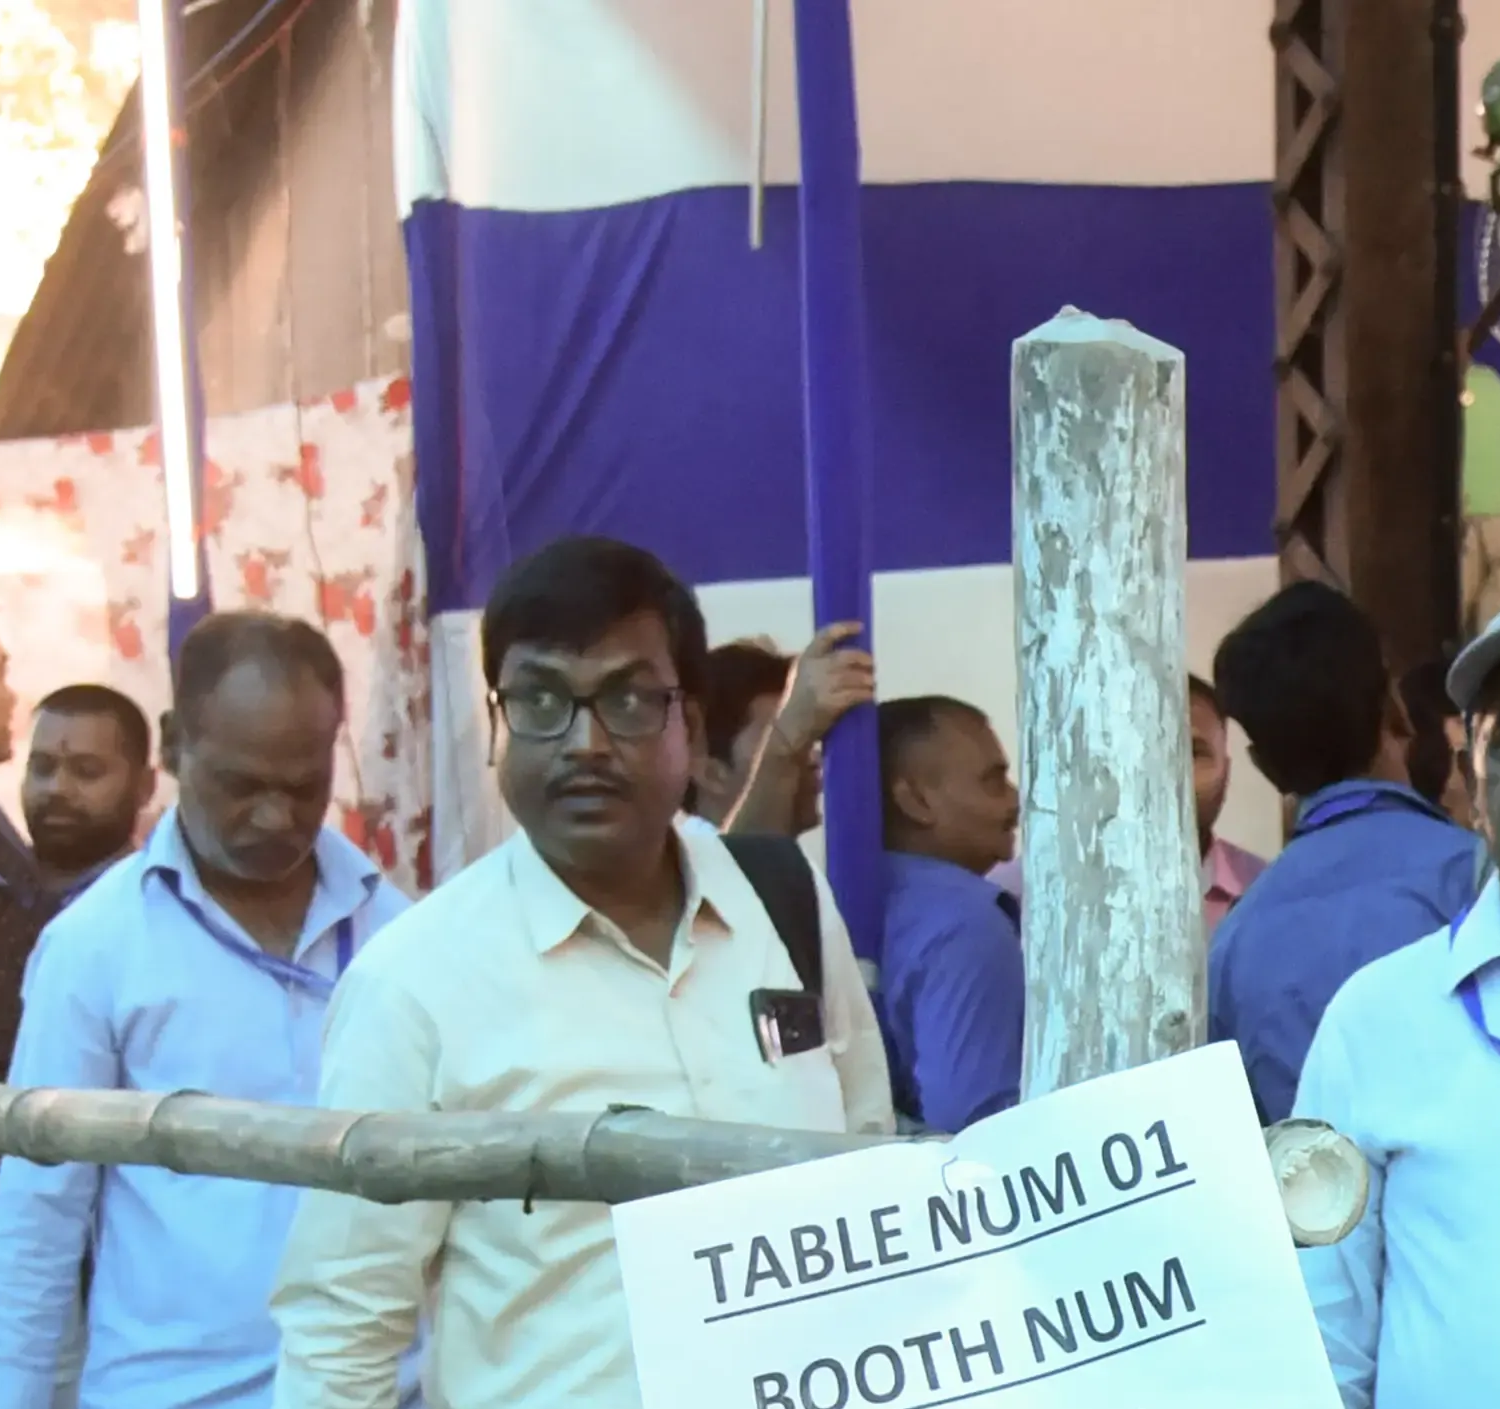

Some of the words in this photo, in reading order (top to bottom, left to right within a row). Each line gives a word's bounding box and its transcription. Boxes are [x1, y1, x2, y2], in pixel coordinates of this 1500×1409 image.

[693, 1204, 908, 1304] TABLE
[927, 1151, 1088, 1251] NUM
[1100, 1119, 1189, 1192] 01
[1024, 1256, 1197, 1364] NUM
